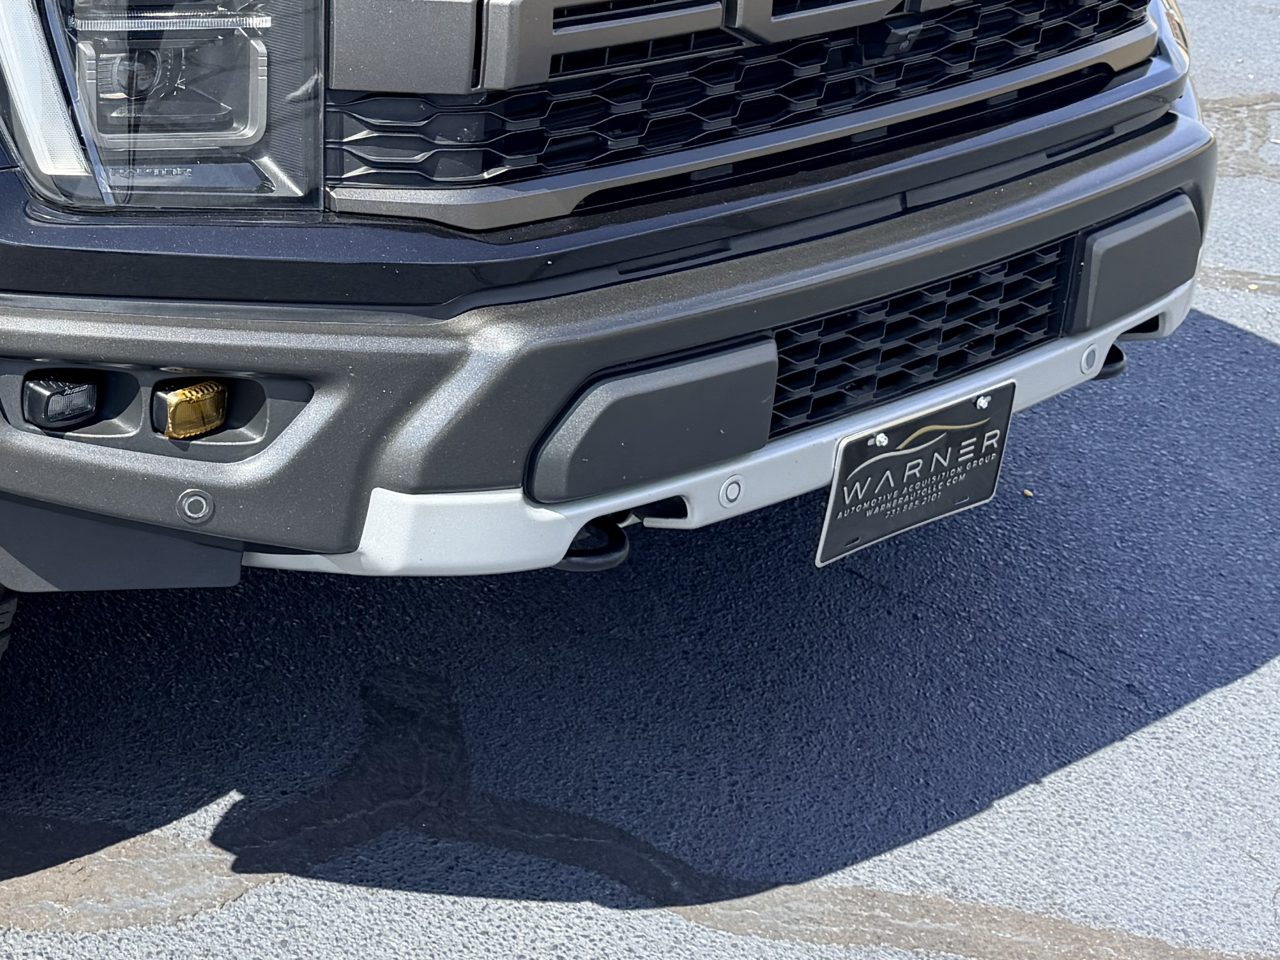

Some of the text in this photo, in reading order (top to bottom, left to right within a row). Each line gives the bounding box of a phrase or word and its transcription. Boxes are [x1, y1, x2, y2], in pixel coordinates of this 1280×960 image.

[837, 452, 997, 520] AUTOMOTIVE ACQUISITION GROUP
[843, 429, 1001, 505] WARNER
